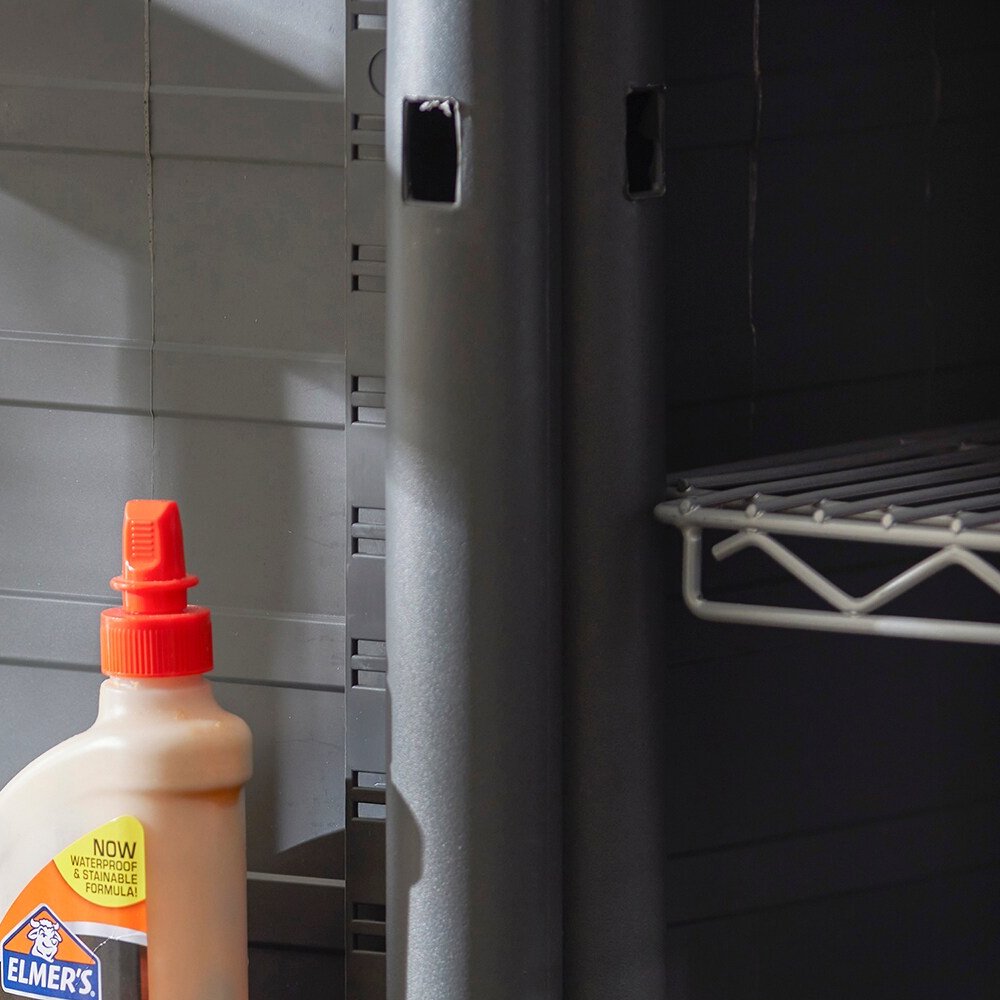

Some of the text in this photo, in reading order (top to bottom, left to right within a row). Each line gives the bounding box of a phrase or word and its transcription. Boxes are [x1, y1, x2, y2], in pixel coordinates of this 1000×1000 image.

[93, 838, 137, 859] NOW
[70, 855, 138, 872] WATERPROOF
[73, 868, 138, 885] & STAINABLE
[85, 882, 138, 897] FORMULA!
[7, 957, 93, 995] ELMER'S
